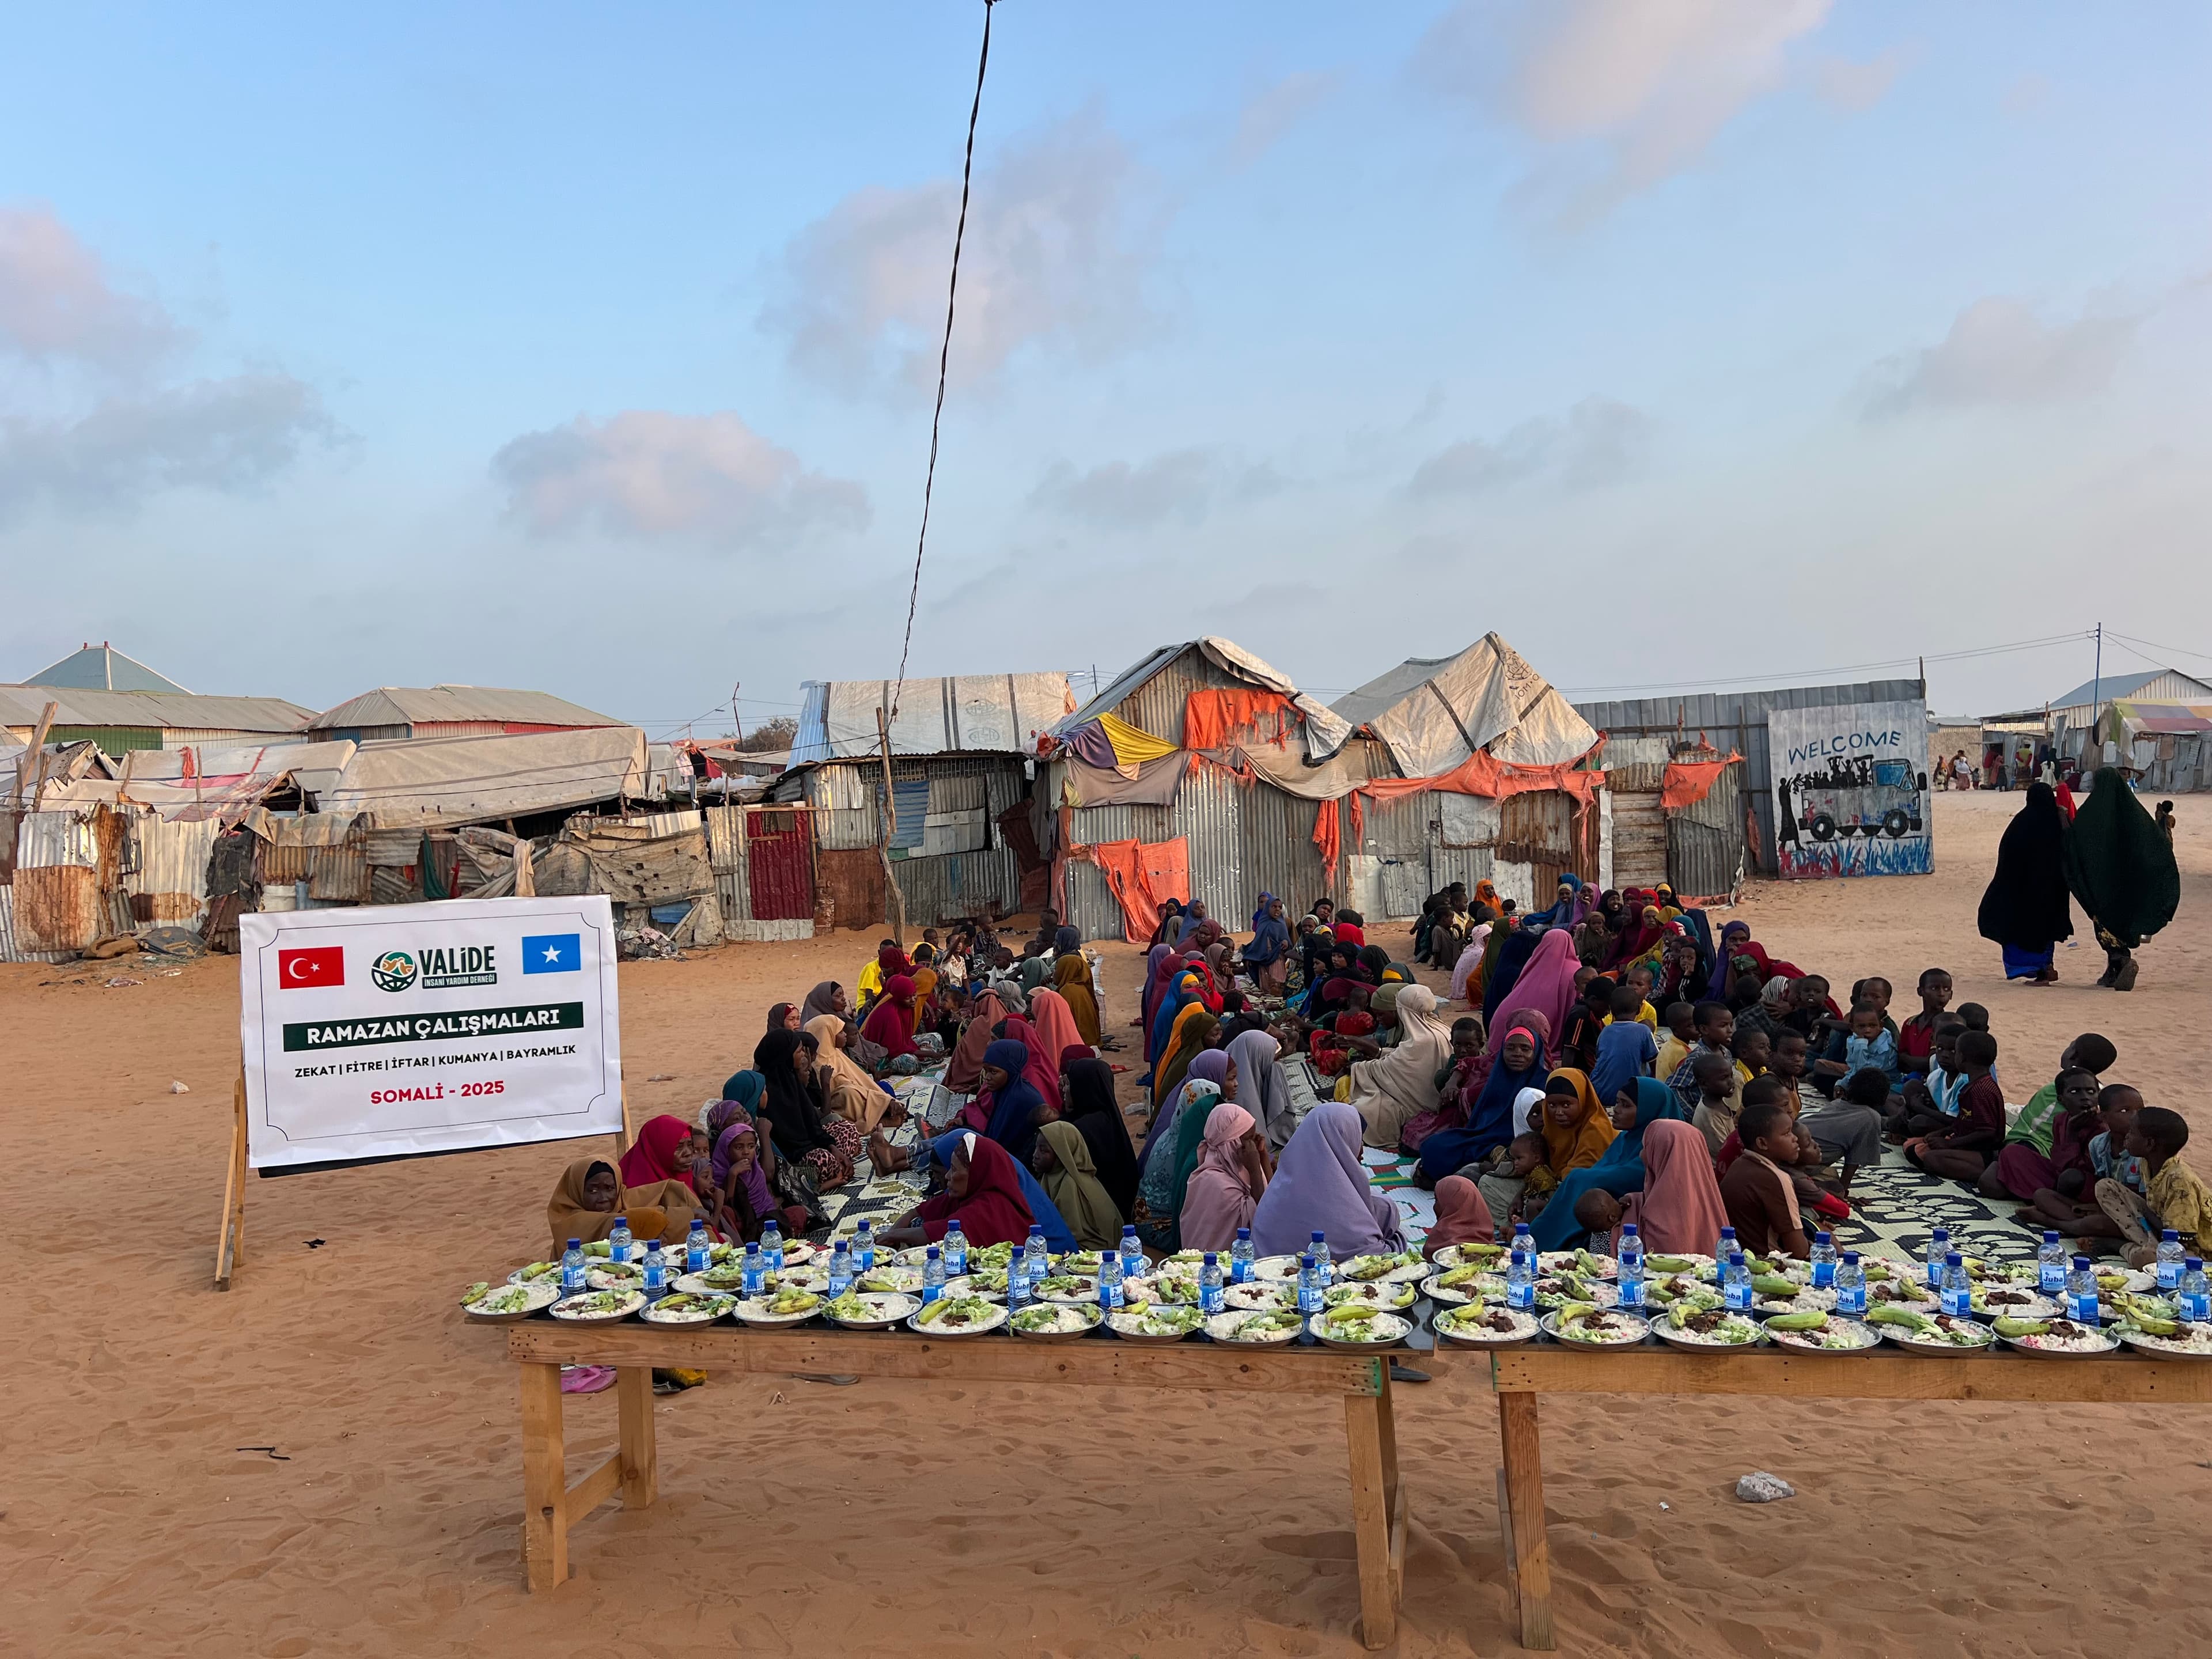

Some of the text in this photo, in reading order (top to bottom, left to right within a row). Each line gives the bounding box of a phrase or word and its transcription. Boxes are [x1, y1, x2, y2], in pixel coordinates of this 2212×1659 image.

[1788, 730, 1901, 765] WELCOME
[446, 976, 469, 986] YARDIM
[307, 1009, 559, 1044] RAMAZAN ÇALIŞMALARI
[295, 1065, 336, 1078] ZEKAT
[346, 1060, 382, 1073] FİTRE
[392, 1056, 429, 1069] İFTAR
[438, 1051, 498, 1065] KUMANYA
[506, 1044, 575, 1059] BAYRAMLIK
[370, 1082, 444, 1104] SOMALİ
[461, 1080, 505, 1097] 2025
[1838, 1296, 1854, 1304] Juba
